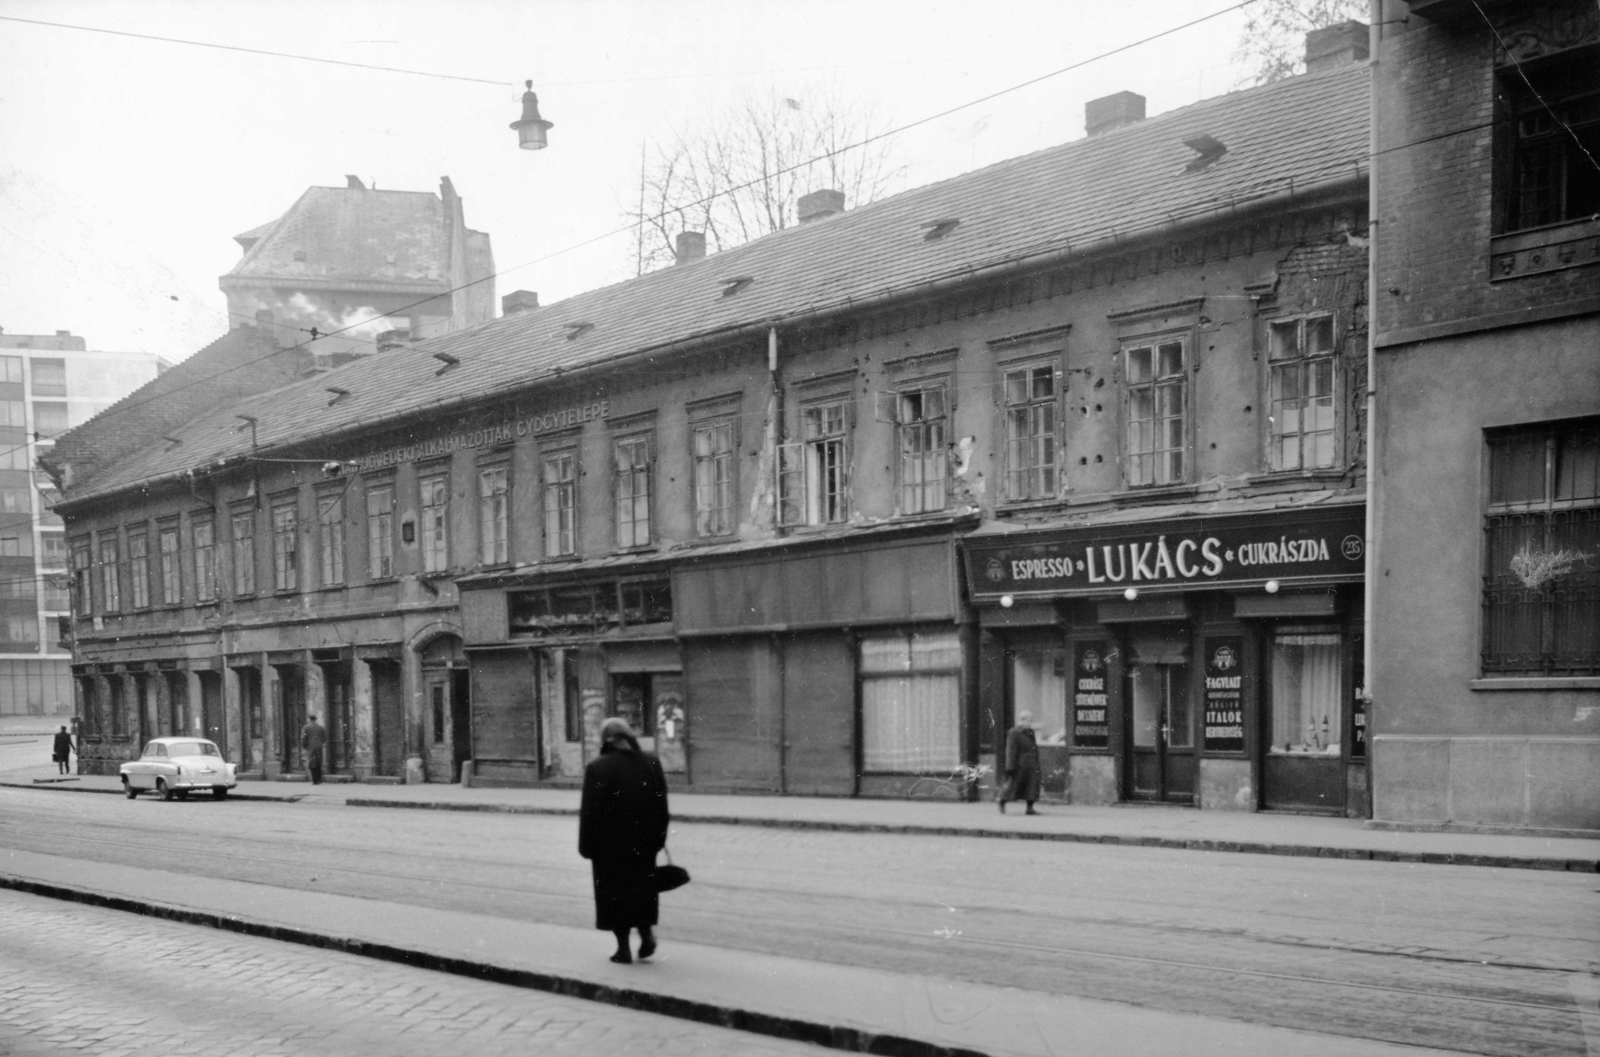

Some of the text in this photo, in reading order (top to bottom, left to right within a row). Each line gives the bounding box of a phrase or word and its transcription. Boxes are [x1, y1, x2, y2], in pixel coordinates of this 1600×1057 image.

[1011, 557, 1073, 580] ESPRESSO
[1238, 536, 1330, 566] CUKRÁSZDA
[1345, 540, 1361, 555] 235
[1206, 676, 1242, 689] FAGYLALT
[1206, 711, 1242, 723] ITALOK
